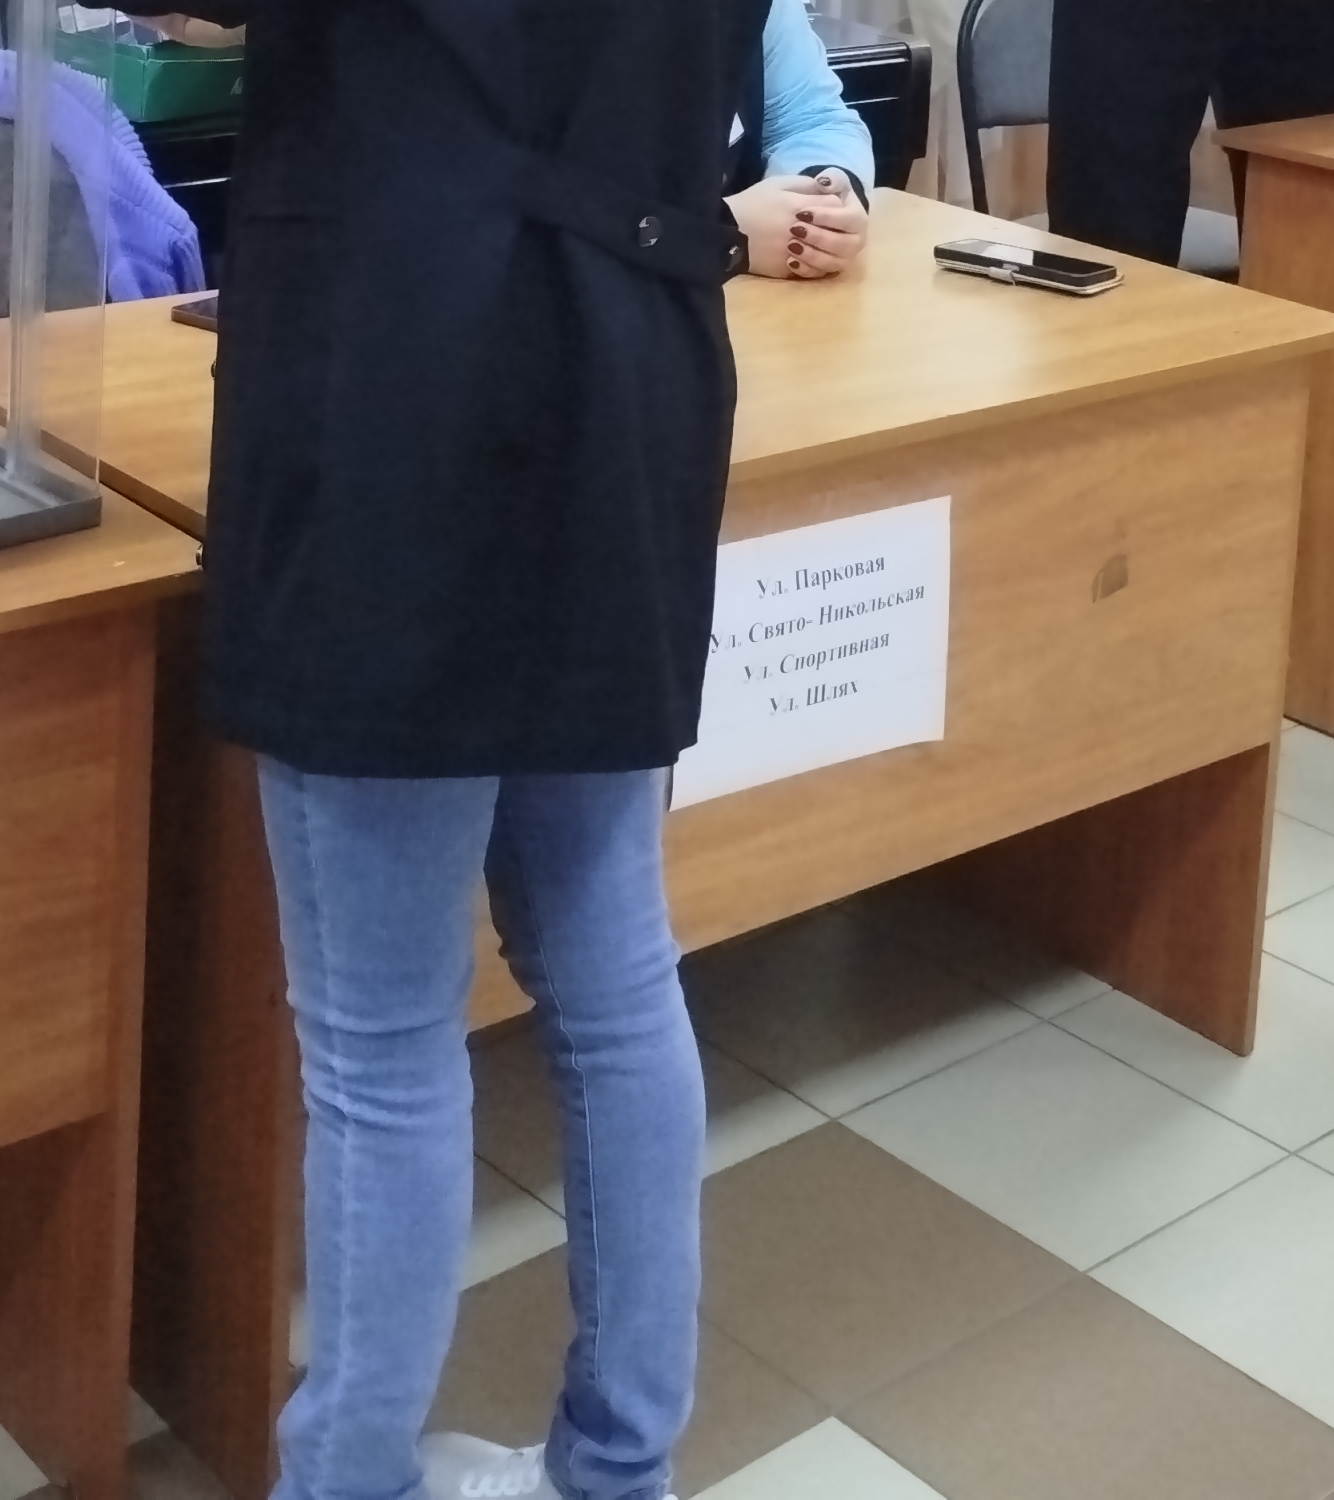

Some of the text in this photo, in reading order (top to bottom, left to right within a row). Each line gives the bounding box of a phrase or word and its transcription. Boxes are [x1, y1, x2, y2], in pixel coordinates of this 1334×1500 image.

[757, 556, 886, 600] Ул. Парковая
[711, 585, 925, 654] Ул. Свято- Никольская
[742, 632, 890, 685] Ул. Спортивная
[769, 680, 859, 716] Ул. Шлях
